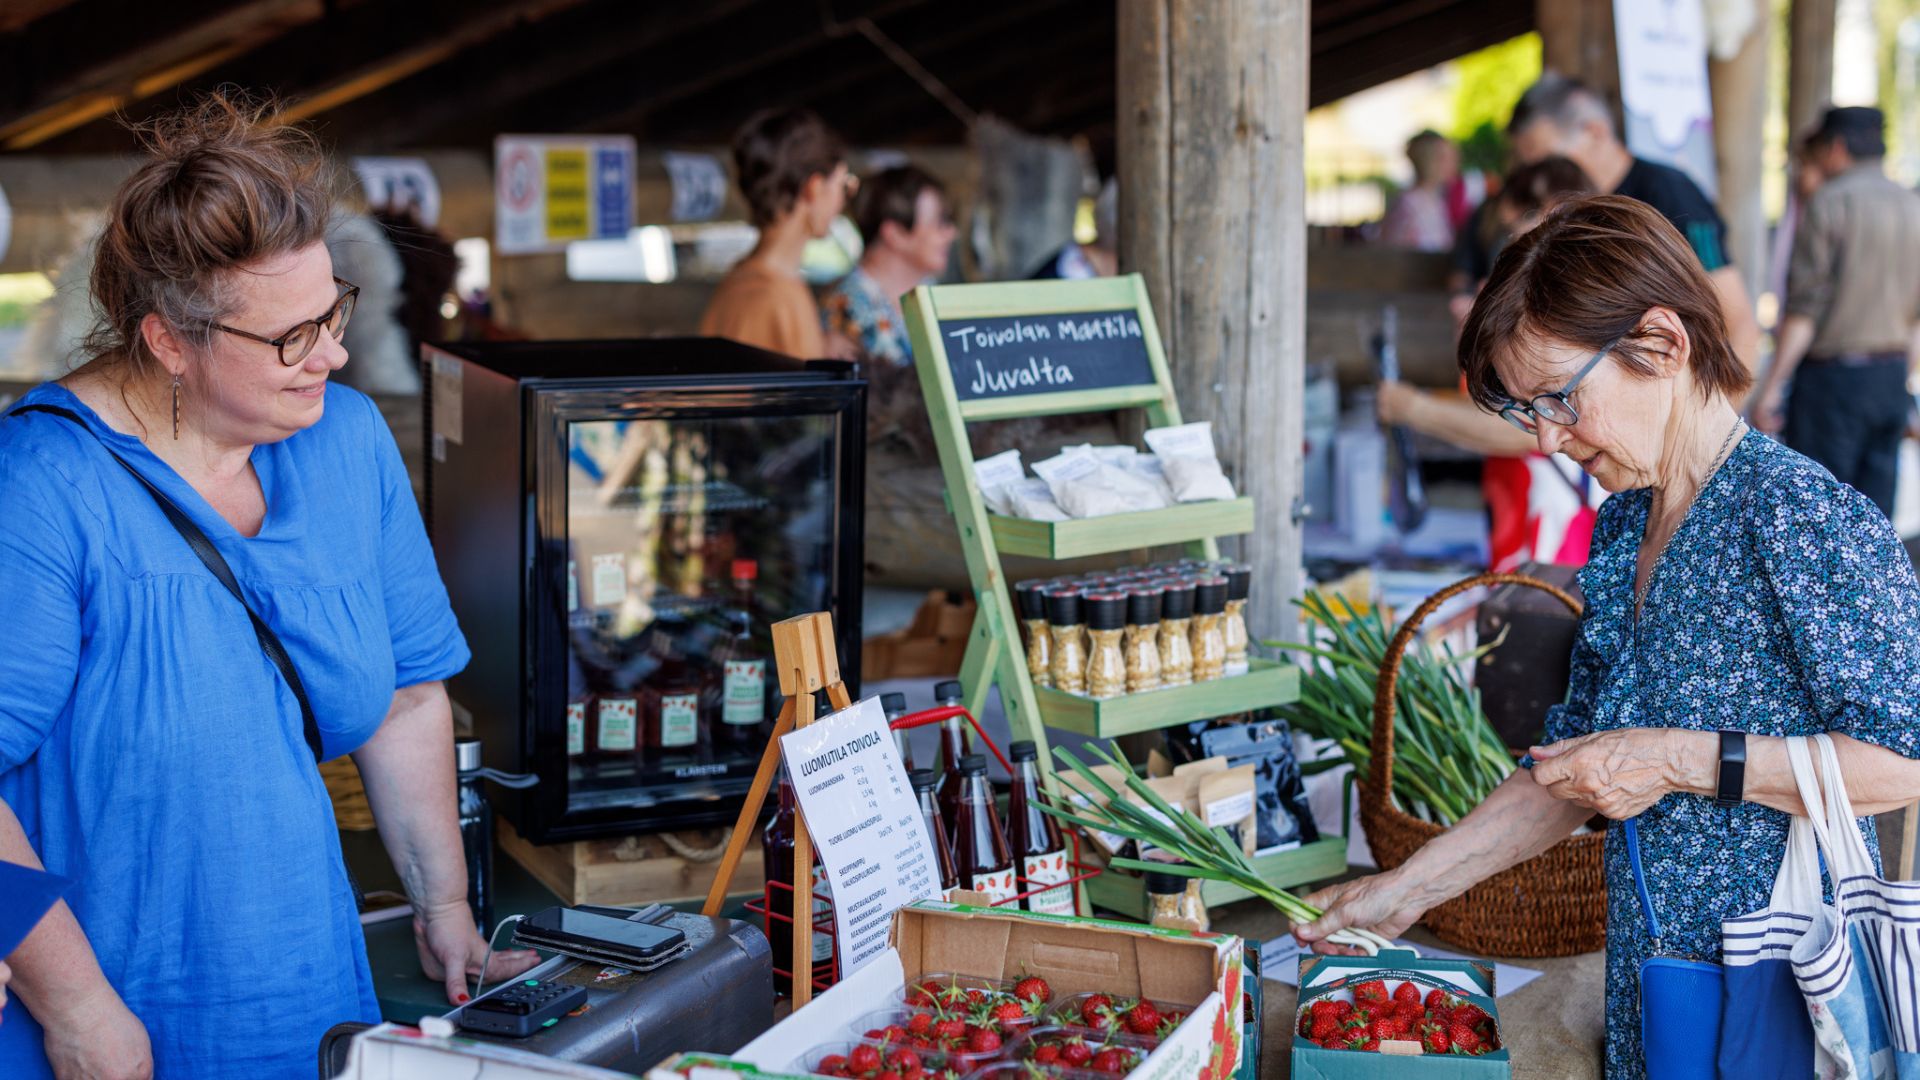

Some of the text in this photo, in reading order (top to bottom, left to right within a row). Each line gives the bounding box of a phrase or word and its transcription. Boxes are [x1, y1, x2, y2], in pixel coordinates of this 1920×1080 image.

[949, 320, 1050, 352] Toivolan
[970, 356, 1073, 394] Juvalta
[801, 730, 881, 777] LUOMUTILA TOIVOLA
